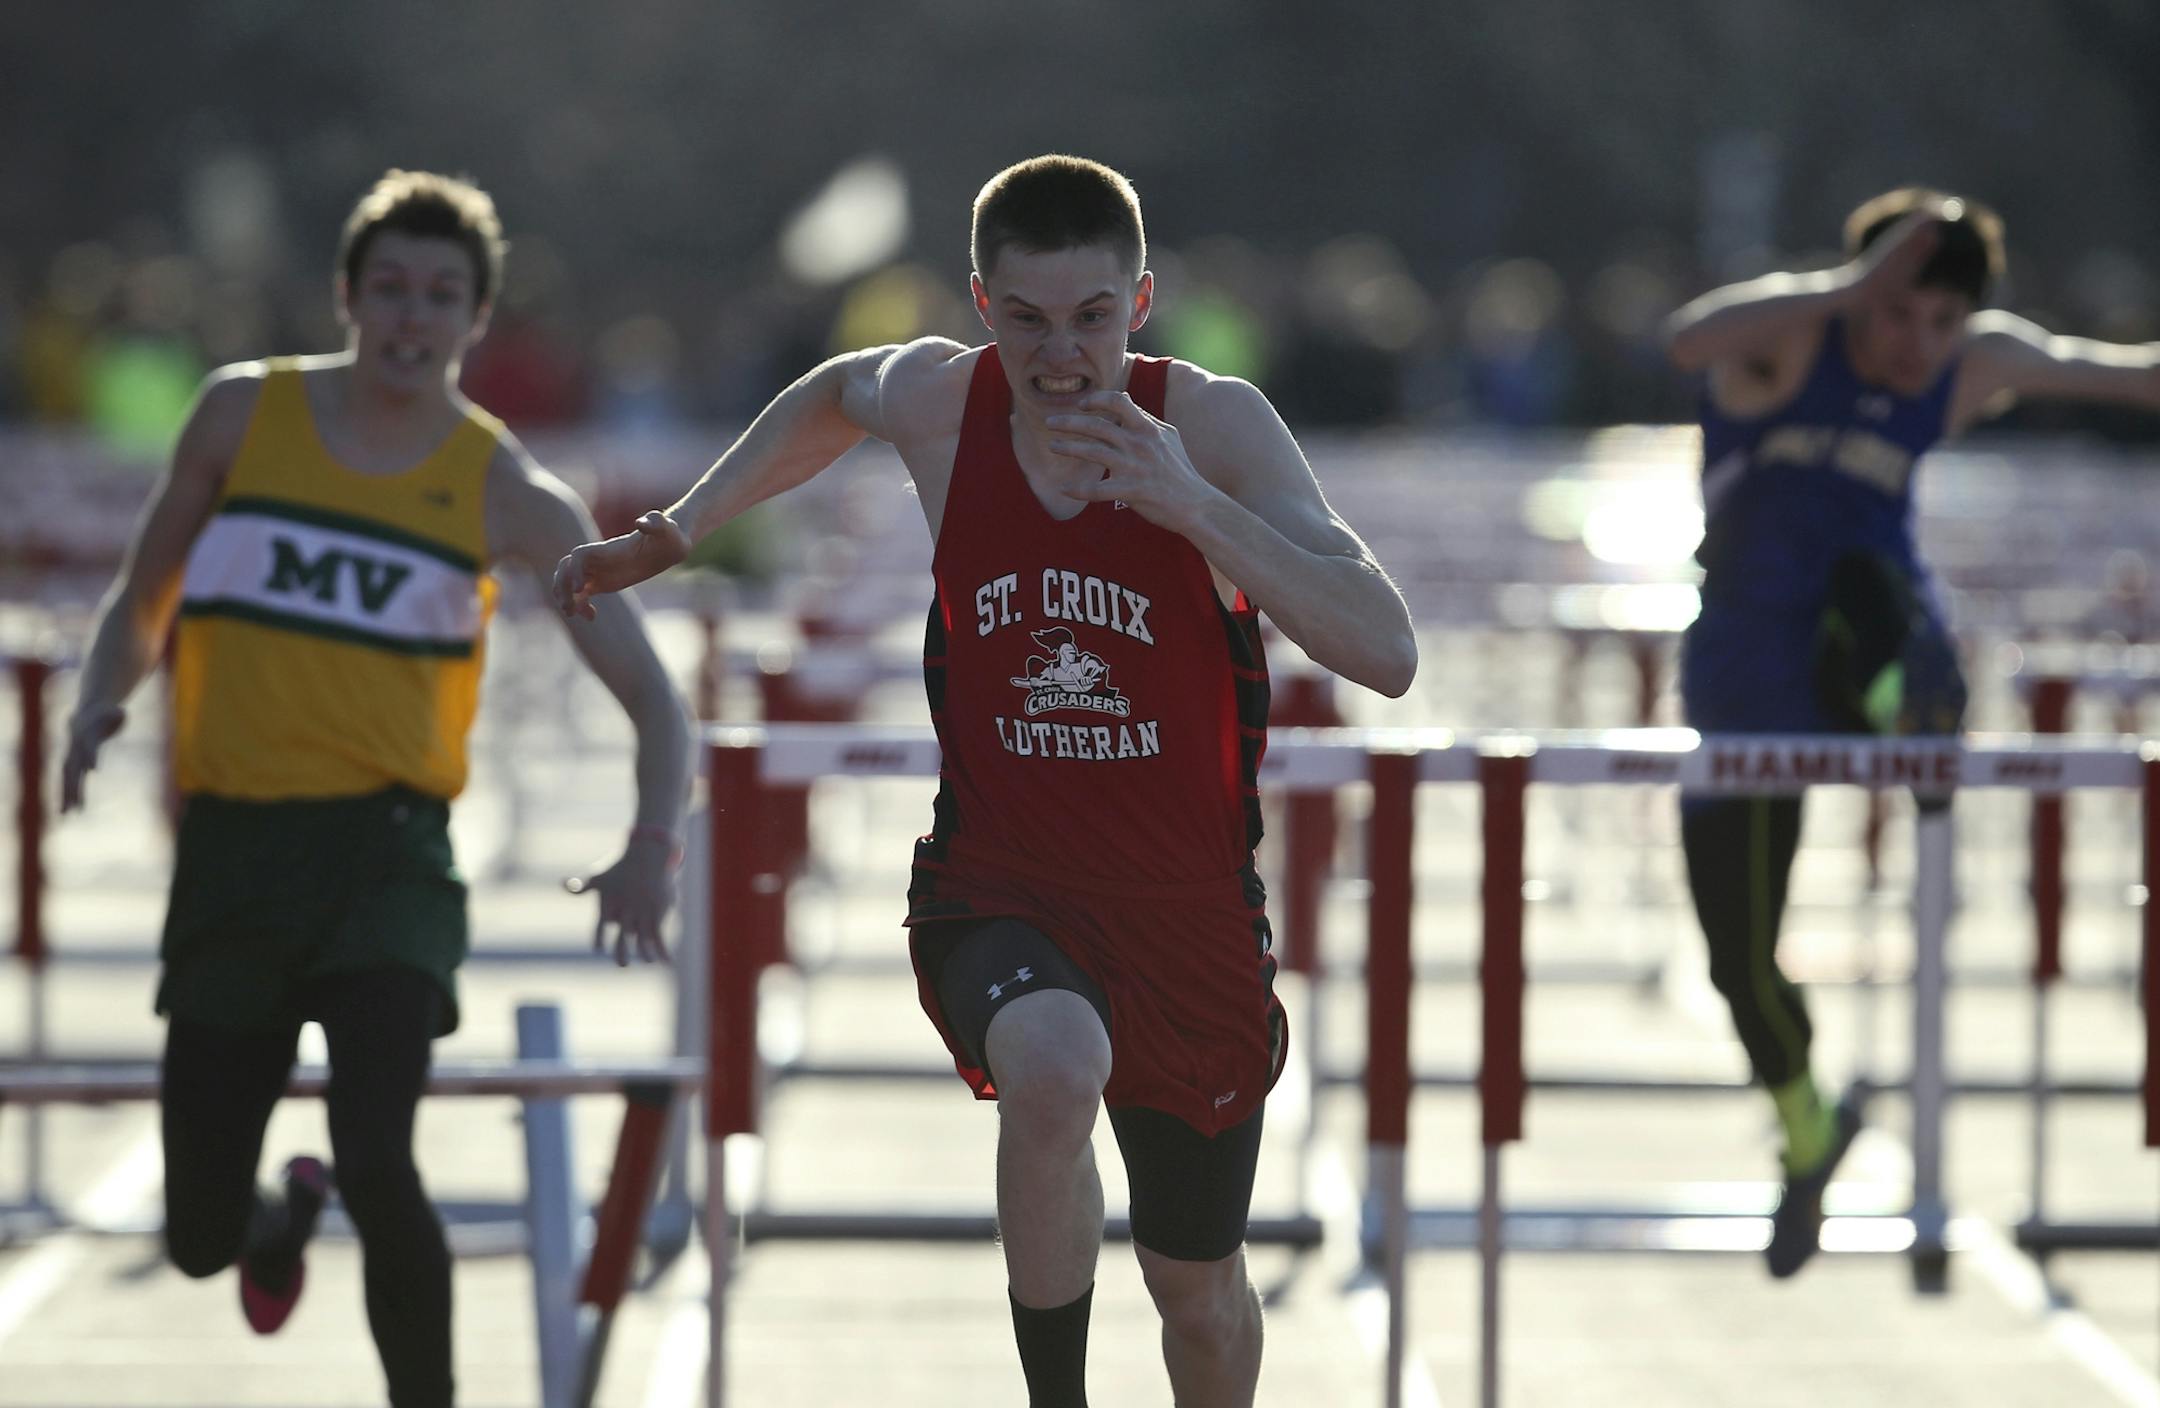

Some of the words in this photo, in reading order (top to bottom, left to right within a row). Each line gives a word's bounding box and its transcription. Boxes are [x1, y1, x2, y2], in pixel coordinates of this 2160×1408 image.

[265, 534, 412, 616] MV
[975, 572, 1022, 637] ST.
[1041, 567, 1154, 645] CROIX
[1027, 692, 1128, 716] CRUSADERS
[995, 716, 1160, 760] LUTHERAN
[1709, 748, 1960, 785] HAMLINE
